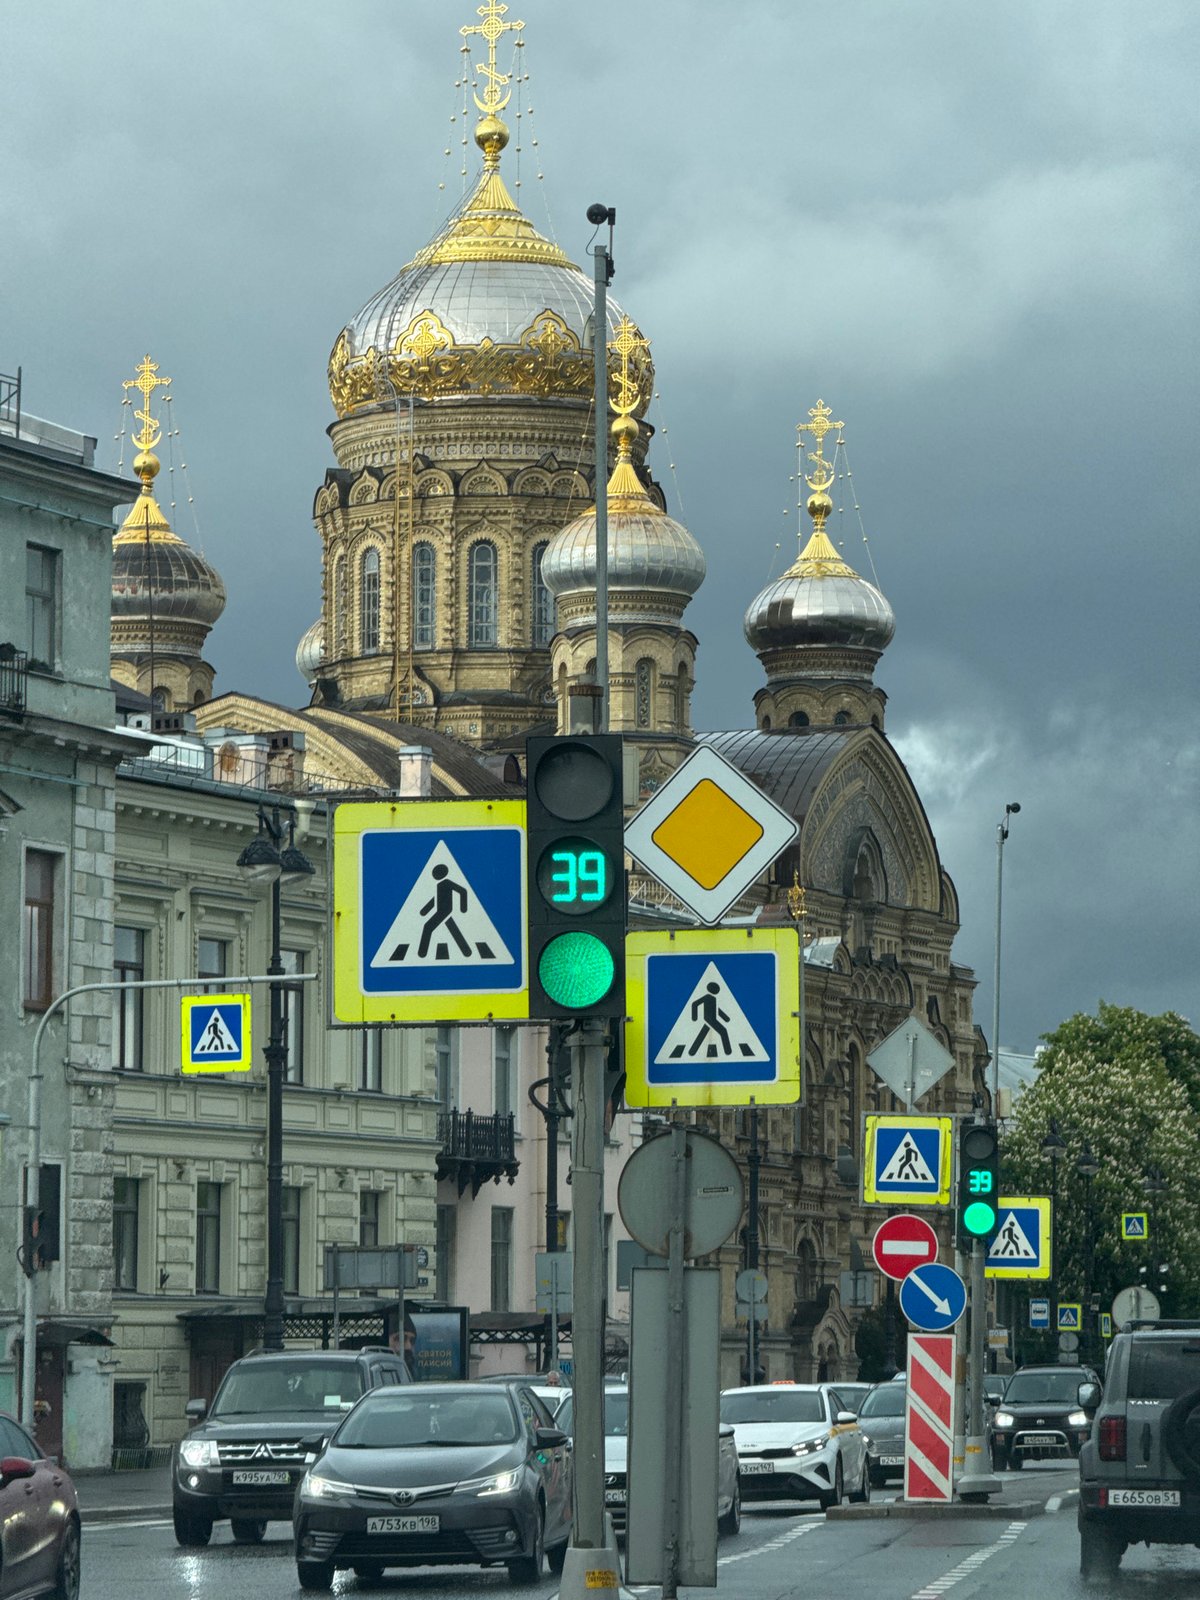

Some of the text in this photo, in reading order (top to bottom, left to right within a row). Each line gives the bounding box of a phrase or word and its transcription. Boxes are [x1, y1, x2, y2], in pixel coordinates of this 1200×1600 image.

[552, 852, 605, 902] 39
[970, 1171, 991, 1192] 39
[1113, 1491, 1178, 1504] Е665ОВ 51
[370, 1517, 437, 1531] А753КВ 198
